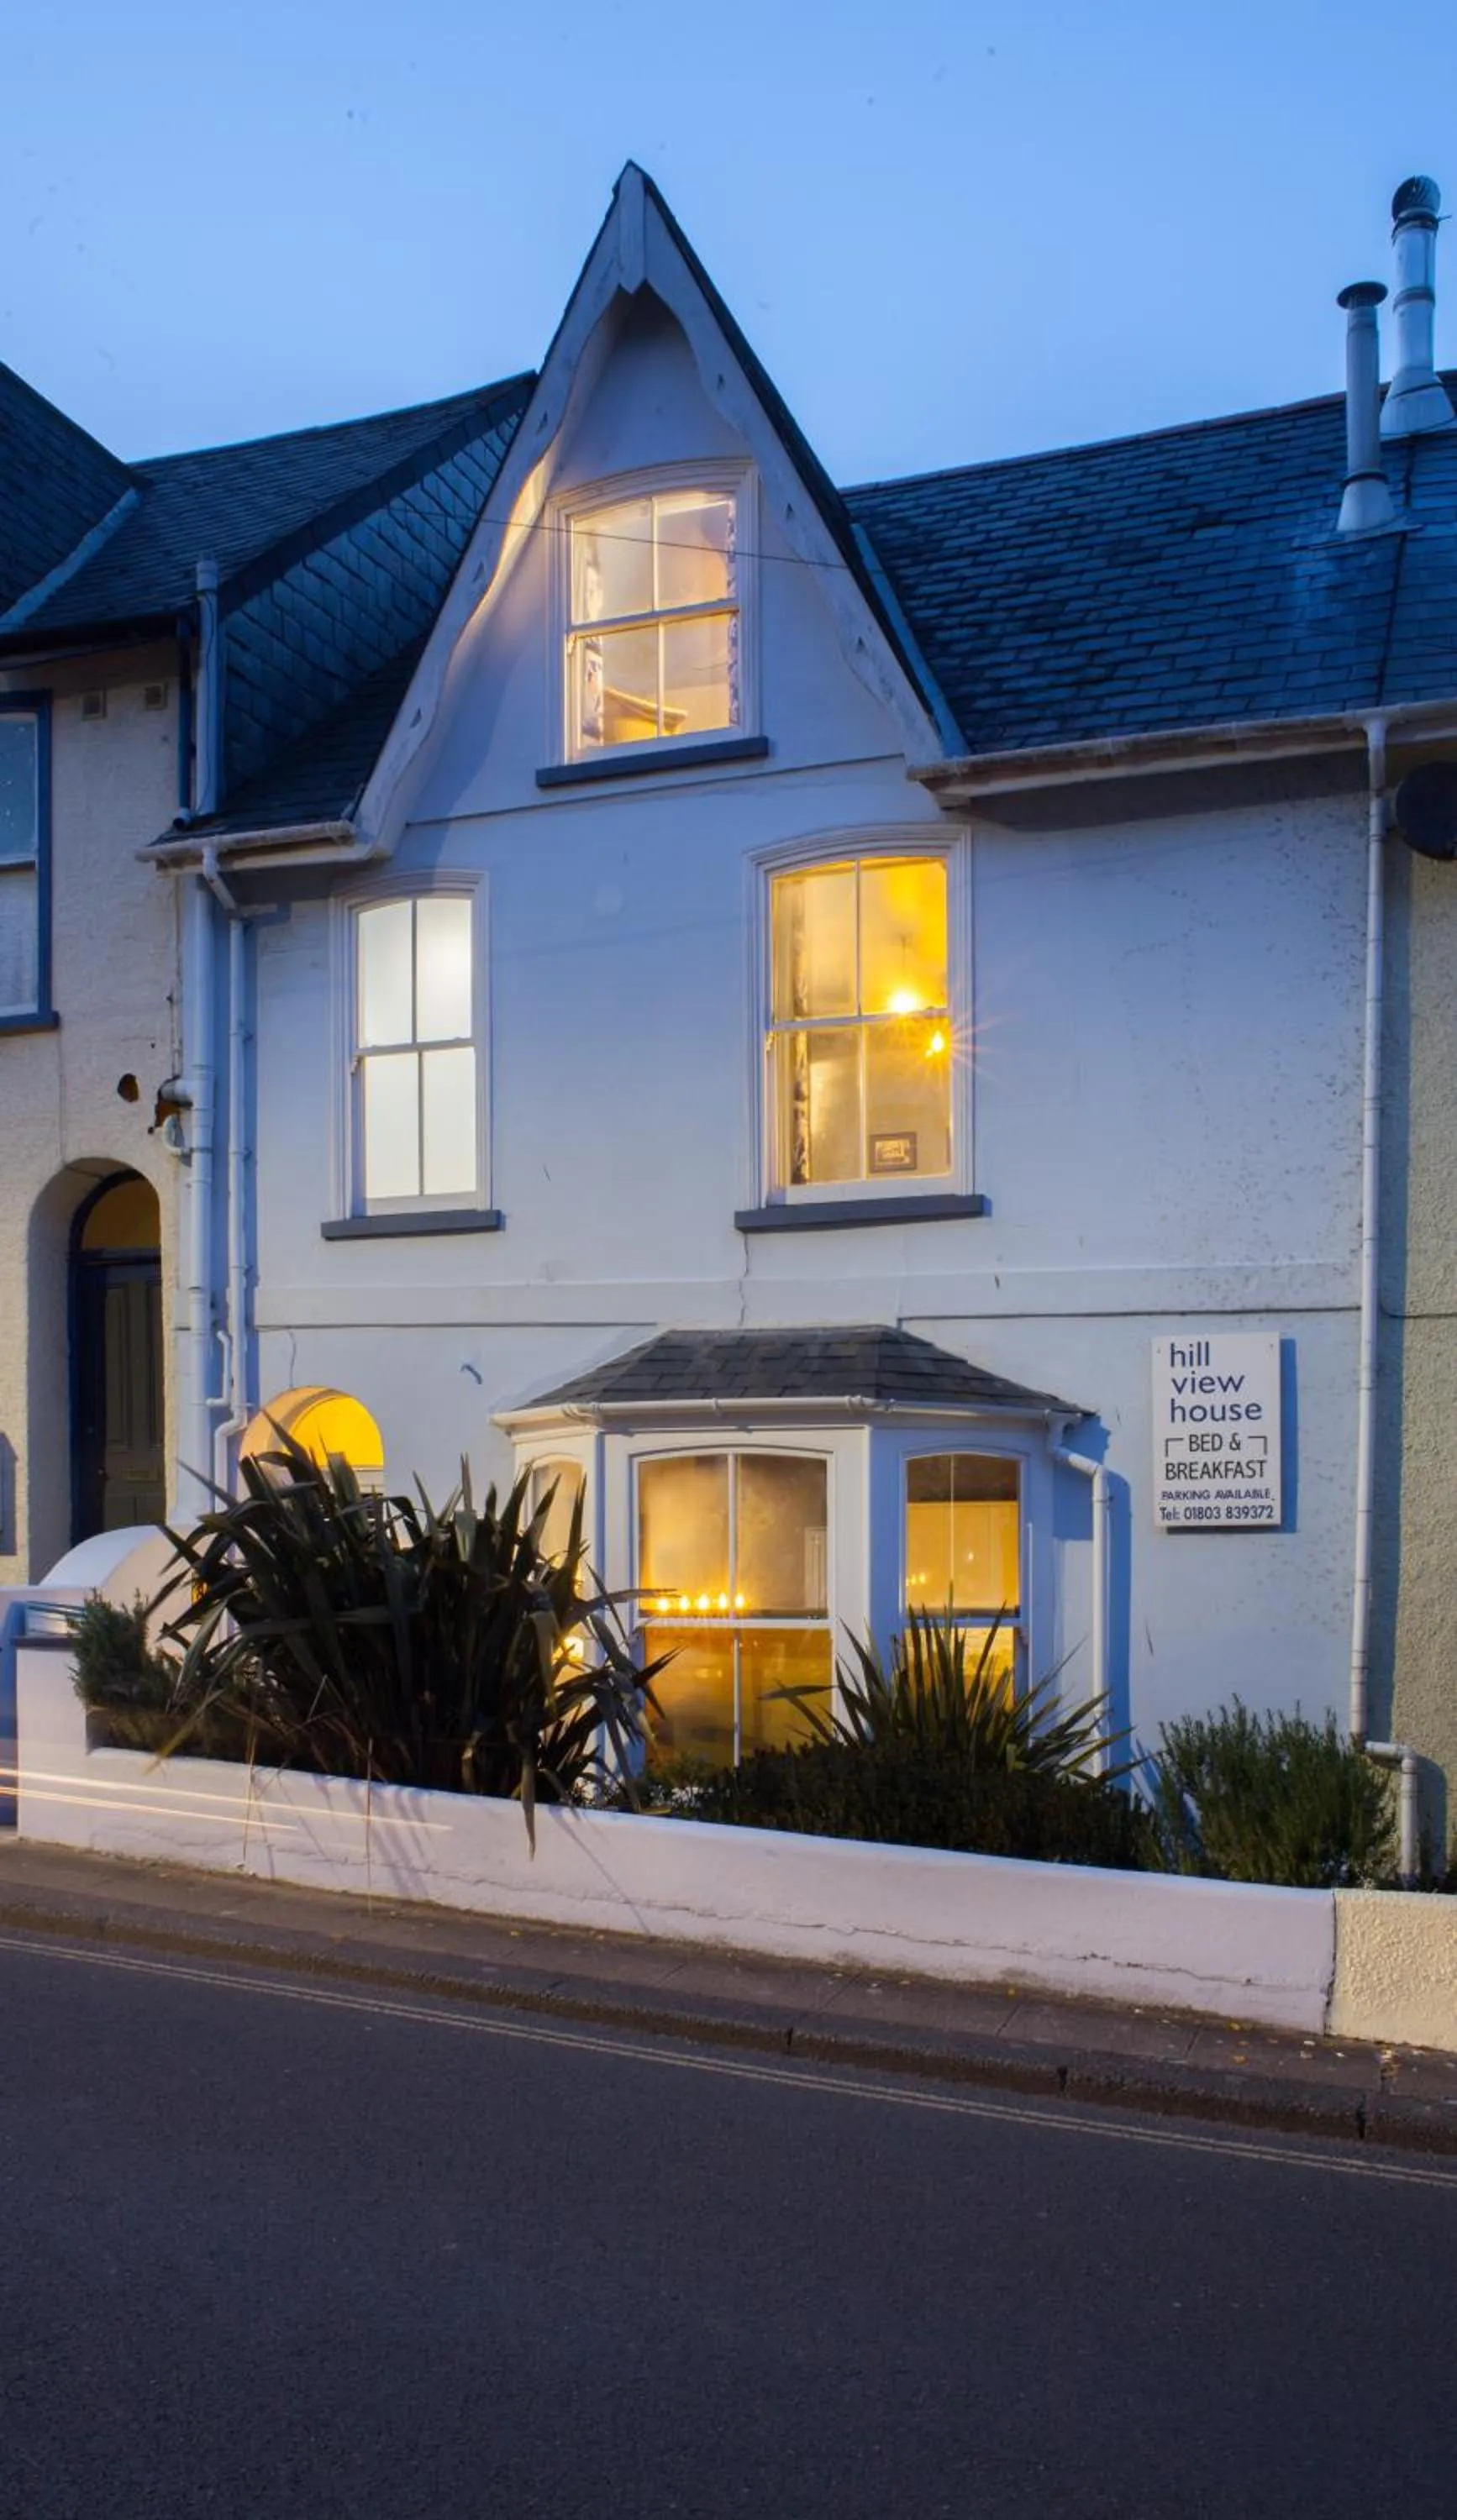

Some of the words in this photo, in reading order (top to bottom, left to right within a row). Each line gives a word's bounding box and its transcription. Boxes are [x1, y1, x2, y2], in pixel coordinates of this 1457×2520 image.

[1170, 1341, 1209, 1368] hill
[1171, 1370, 1245, 1394] view
[1170, 1398, 1262, 1423] house
[1189, 1433, 1223, 1452] BED
[1229, 1432, 1241, 1452] &
[1165, 1460, 1267, 1480] BREAKFAST
[1161, 1489, 1211, 1501] PARKING
[1184, 1505, 1221, 1520] 01803
[1226, 1504, 1274, 1520] 839372
